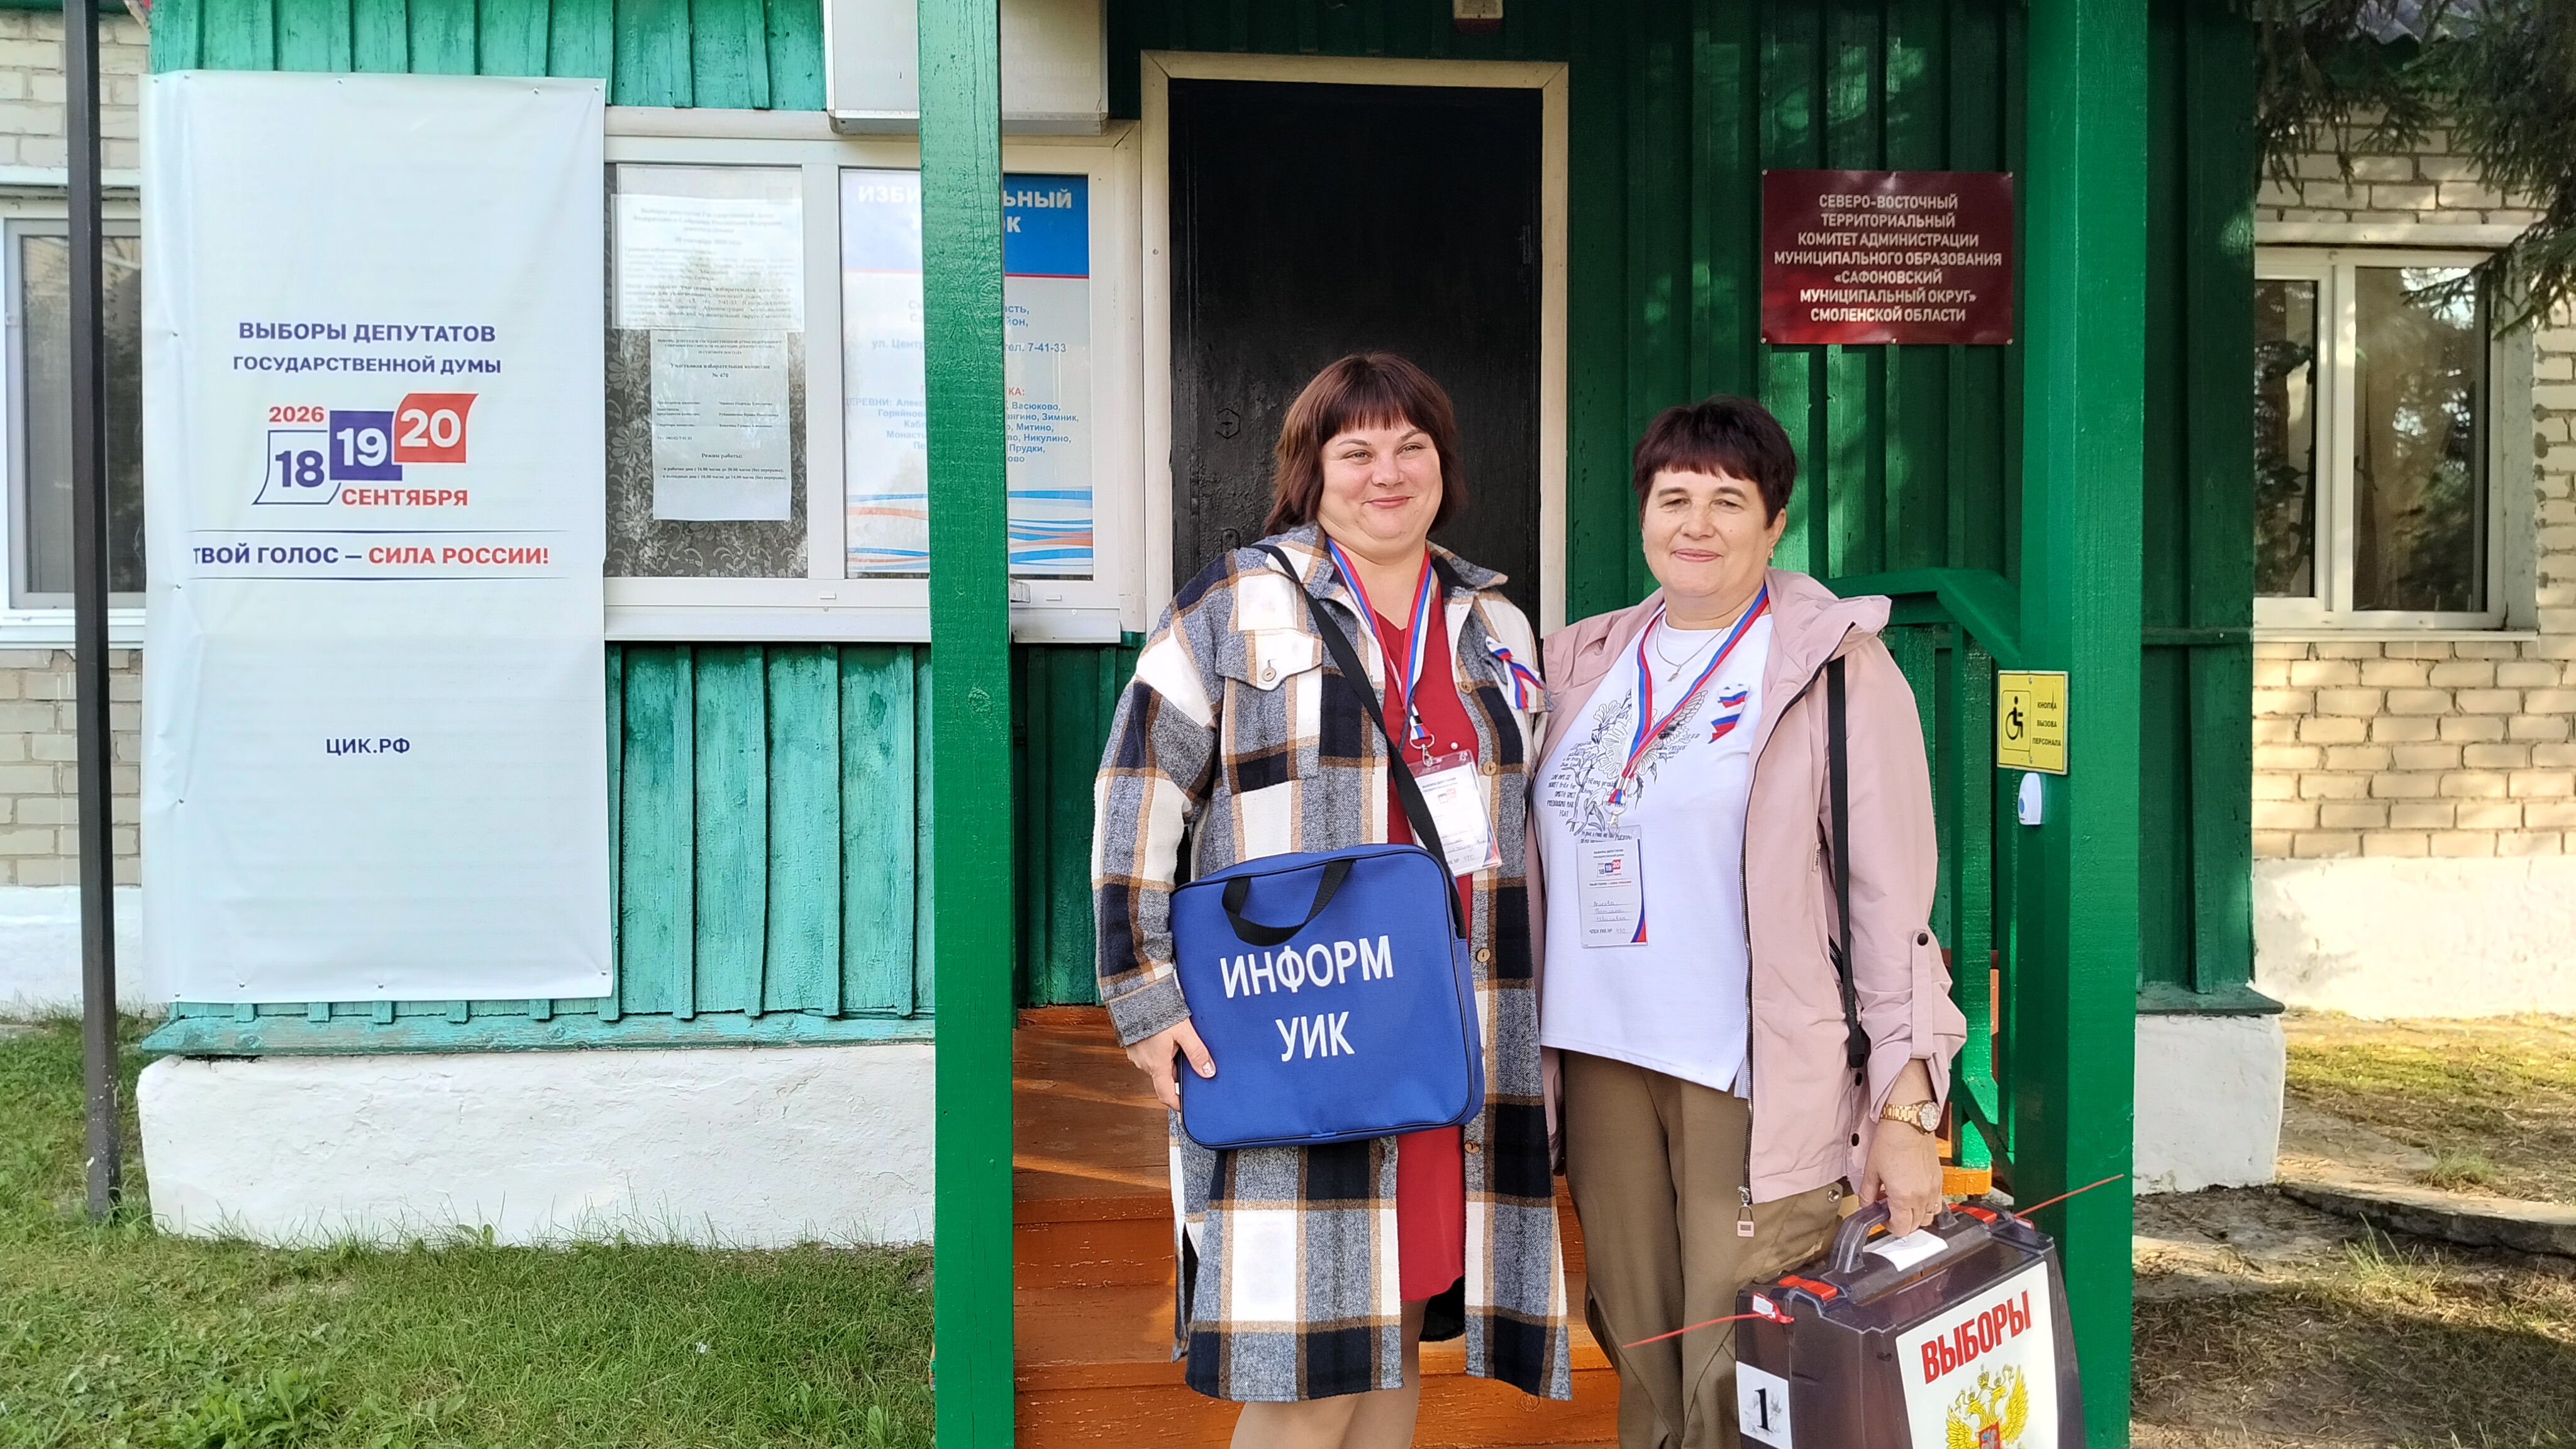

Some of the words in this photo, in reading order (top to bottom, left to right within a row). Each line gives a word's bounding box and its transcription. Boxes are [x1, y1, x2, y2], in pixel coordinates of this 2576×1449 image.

[1819, 194, 1958, 209] СЕВЕРО-ВОСТОЧНЫЙ
[1821, 213, 1955, 228] ТЕРРИТОРИАЛЬНЫЙ
[1798, 233, 1857, 246] КОМИТЕТ
[1860, 233, 1979, 248] АДМИНИСТРАЦИИ
[1774, 251, 1903, 265] МУНИЦИПАЛЬНОГО
[1905, 253, 2002, 265] ОБРАЗОВАНИЯ
[1835, 269, 1942, 284] «САФОНОВСКИЙ
[1800, 287, 1925, 303] МУНИЦИПАЛЬНЫЙ
[1928, 290, 1977, 303] ОКРУГ»
[1811, 306, 1901, 321] СМОЛЕНСКОЙ
[1904, 309, 1966, 321] ОБЛАСТИ
[239, 322, 347, 341] ВЫБОРЫ
[353, 323, 496, 343] ДЕПУТАТОВ
[1028, 343, 1066, 353] 7-41-33
[233, 355, 435, 374] ГОСУДАРСТВЕННОЙ
[440, 357, 501, 375] ДУМЫ
[1011, 401, 1061, 411] Васюково,
[269, 406, 325, 423] 2026
[1042, 413, 1079, 423] Зимник,
[1016, 423, 1054, 433] Митино,
[1023, 433, 1072, 444] Никулино,
[275, 450, 325, 489] 18
[336, 426, 388, 468] 19
[399, 409, 462, 448] 20
[1009, 443, 1046, 453] Прудки,
[341, 489, 469, 506] СЕНТЯБРЯ
[257, 547, 339, 565] ГОЛОС
[369, 547, 436, 565] СИЛА
[442, 547, 549, 565] РОССИИ!
[2037, 719, 2057, 728] ВЫЗОВА
[326, 738, 410, 756] ЦИК.РФ
[2032, 738, 2061, 747] ПЕРСОНАЛА
[1220, 935, 1394, 998] ИНФОРМ
[1275, 1011, 1355, 1062] УИК
[1921, 1290, 2031, 1385] ВЫБОРЫ
[1754, 1387, 1774, 1433] 1
